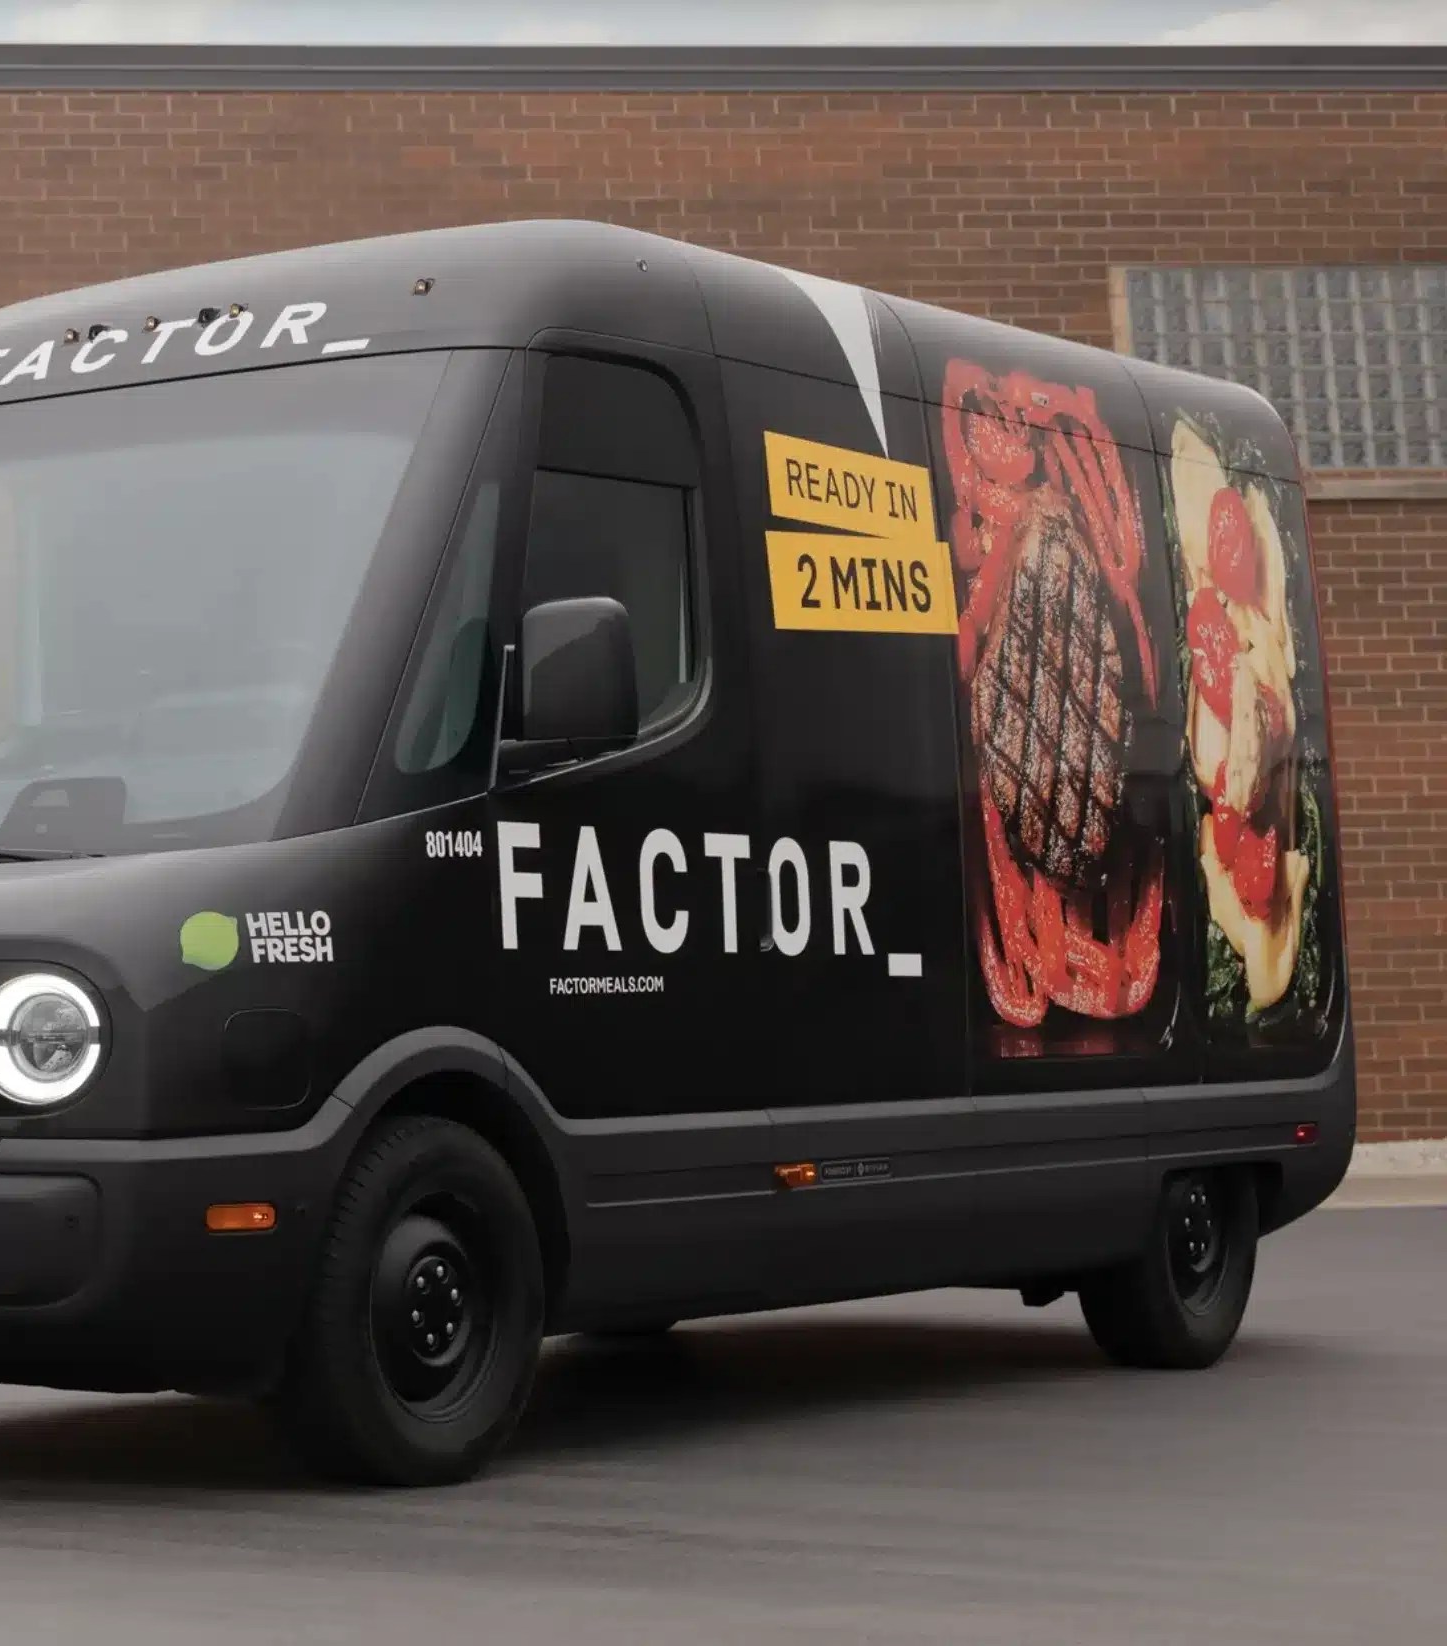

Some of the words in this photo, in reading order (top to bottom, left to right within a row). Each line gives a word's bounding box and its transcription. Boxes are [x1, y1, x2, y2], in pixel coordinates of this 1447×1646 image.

[785, 458, 875, 523] READY
[885, 481, 918, 522] IN
[797, 553, 821, 608] 2
[829, 555, 931, 613] MINS
[425, 830, 483, 858] 801404
[245, 910, 331, 937] HELLO
[250, 936, 334, 963] FRESH
[549, 976, 664, 995] FACTORMEALS.COM
